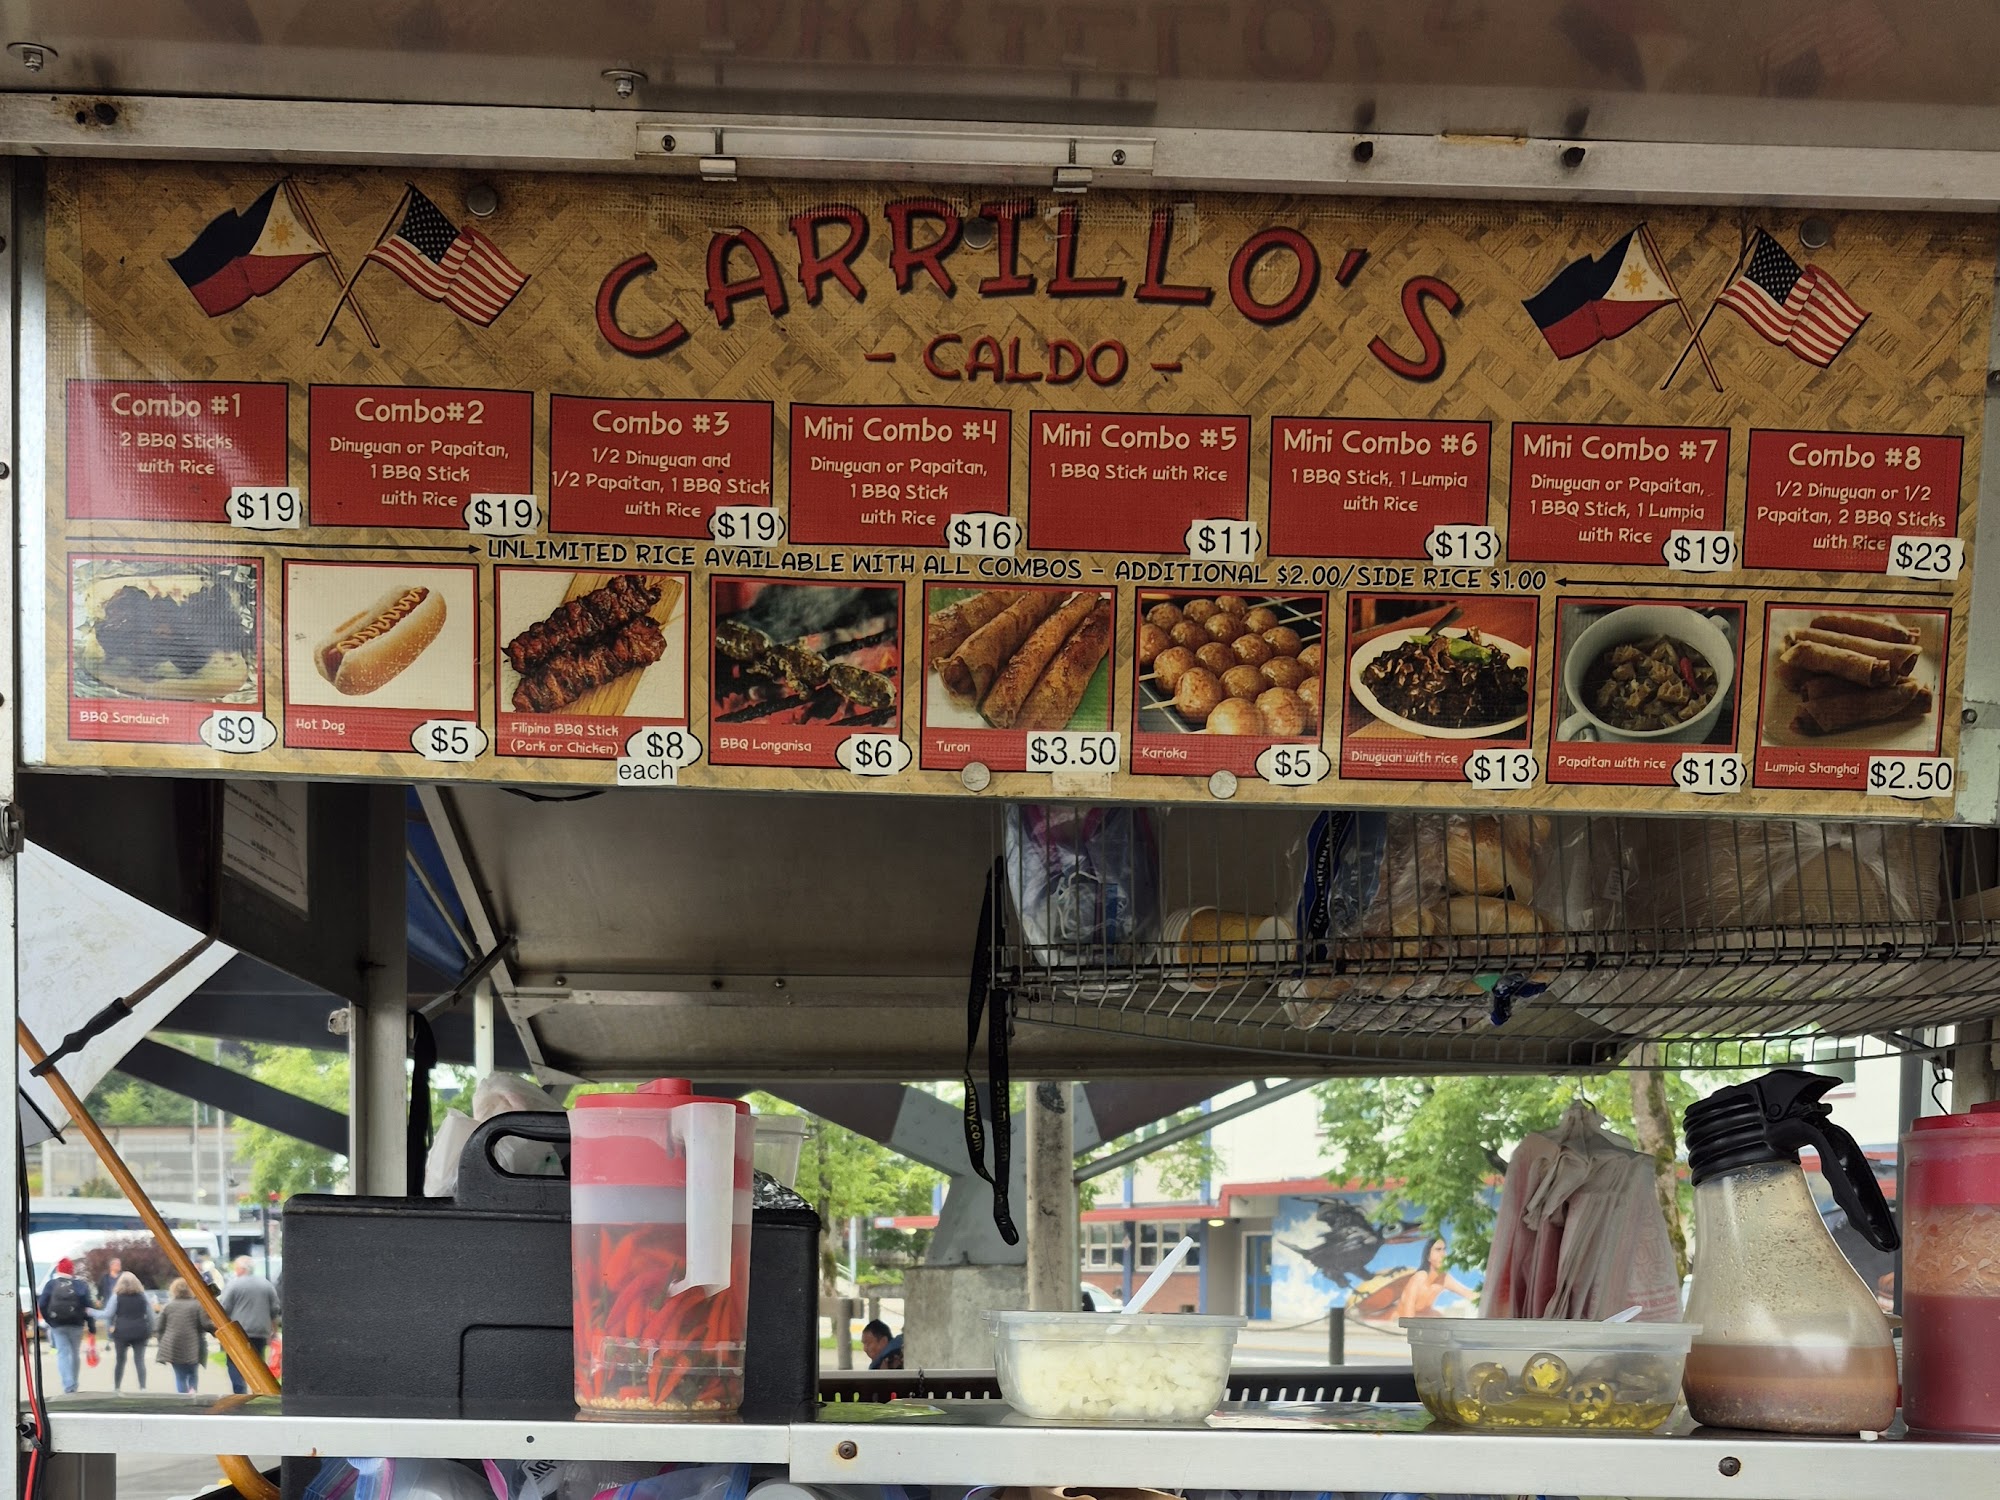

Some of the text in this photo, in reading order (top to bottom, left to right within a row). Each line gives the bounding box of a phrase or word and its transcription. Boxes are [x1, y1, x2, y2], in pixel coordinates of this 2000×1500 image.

[596, 199, 1463, 383] CARRILLO'S
[923, 333, 1129, 385] CALDO
[111, 393, 240, 420] Combo #1
[593, 410, 729, 435] Combo #3
[805, 416, 996, 443] Mini Combo #4
[120, 432, 232, 452] 2 BBQ Sticks
[330, 437, 508, 459] Dinuguan or Papaitan,
[1043, 423, 1236, 450] Mini Combo #5
[1284, 429, 1477, 456] Mini Combo #6
[592, 447, 730, 472] 1/2 Dinuguan and
[1524, 434, 1717, 463] Mini Combo #7
[1789, 443, 1921, 470] Combo #8
[137, 459, 215, 474] with Rice
[371, 464, 469, 481] 1 BBQ Stick
[811, 457, 987, 478] Dinuguan or Papaitan,
[1050, 463, 1227, 481] 1 BBQ Stick with Rice
[552, 471, 769, 494] 1/2 Papaitan, 1 BBQ Stick
[1292, 468, 1467, 490] 1 BBQ Stick, 1 Lumpia
[1531, 474, 1704, 496] Dinuguan or Papaitan,
[382, 490, 457, 506] with Rice
[851, 484, 948, 500] 1 BBQ Stick
[1344, 496, 1418, 511] with Rice
[1776, 481, 1931, 504] 1/2 Dinuguan or 1/2
[237, 492, 293, 521] $19
[475, 499, 532, 528] $19
[626, 501, 701, 517] with Rice
[861, 510, 936, 525] with Rice
[1531, 500, 1704, 522] 1 BBQ Stick, 1 Lumpia
[1758, 507, 1945, 527] Papaitan, 2 BBQ Sticks
[718, 512, 774, 540] $19
[954, 520, 1010, 549] $16
[1579, 527, 1652, 543] with Rice
[1199, 526, 1250, 554] $11
[1436, 531, 1491, 559] $13
[1674, 535, 1729, 564] $19
[1813, 534, 1885, 550] with Rice
[489, 540, 627, 562] UNLIMITED
[636, 545, 695, 565] RICE
[705, 546, 844, 572] AVAILABLE
[854, 555, 914, 573] WITH
[924, 556, 973, 574] ALL
[979, 558, 1081, 578] COMBOS
[1115, 561, 1267, 583] ADDITIONAL
[1424, 568, 1481, 587] RICE
[1491, 570, 1545, 589] $1.00
[1896, 541, 1951, 572] $23
[80, 711, 169, 724] BBQ Sandwich
[296, 719, 345, 735] Hot Dog
[512, 722, 618, 736] Filipino BBQ Stick
[218, 716, 254, 744] $9
[431, 726, 468, 754] $5
[511, 739, 545, 752] (Pork
[567, 742, 618, 756] Chicken)
[647, 732, 683, 759] $8
[720, 738, 811, 754] BBQ Longanisa
[856, 739, 891, 767] $6
[936, 741, 970, 752] Turon
[1031, 737, 1116, 765] $3.50
[1142, 747, 1187, 759] Karioka
[619, 760, 673, 779] each
[1275, 750, 1310, 777] $5
[1352, 751, 1458, 766] Dinuguan with rice
[1474, 755, 1529, 782] $13
[1558, 756, 1666, 769] Papaitan with rice
[1765, 761, 1859, 778] Lumpia Shanghai
[1683, 758, 1737, 785] $13
[1871, 761, 1952, 790] $2.50
